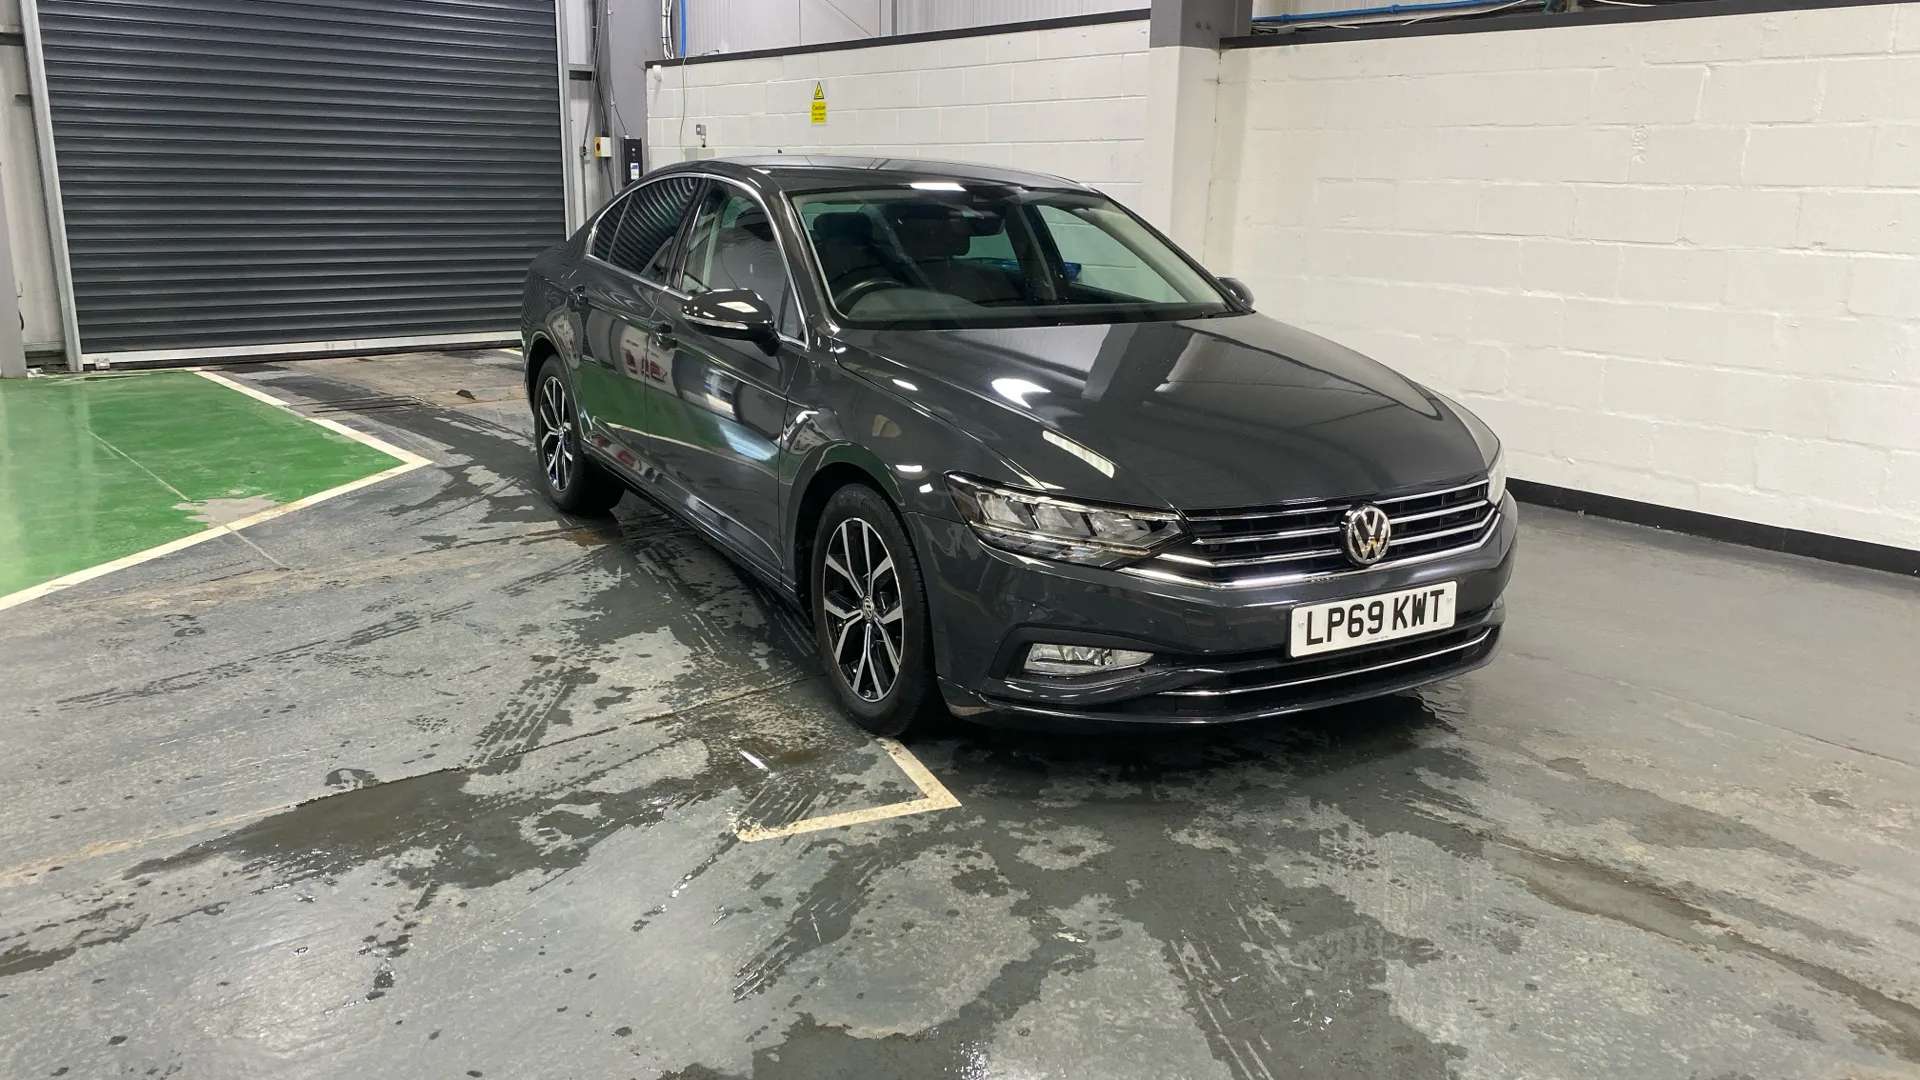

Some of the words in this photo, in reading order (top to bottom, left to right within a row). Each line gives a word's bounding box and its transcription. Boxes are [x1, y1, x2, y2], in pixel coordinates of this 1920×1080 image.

[1349, 507, 1390, 563] VW
[1306, 601, 1384, 646] LP69
[1392, 589, 1445, 631] KWT
